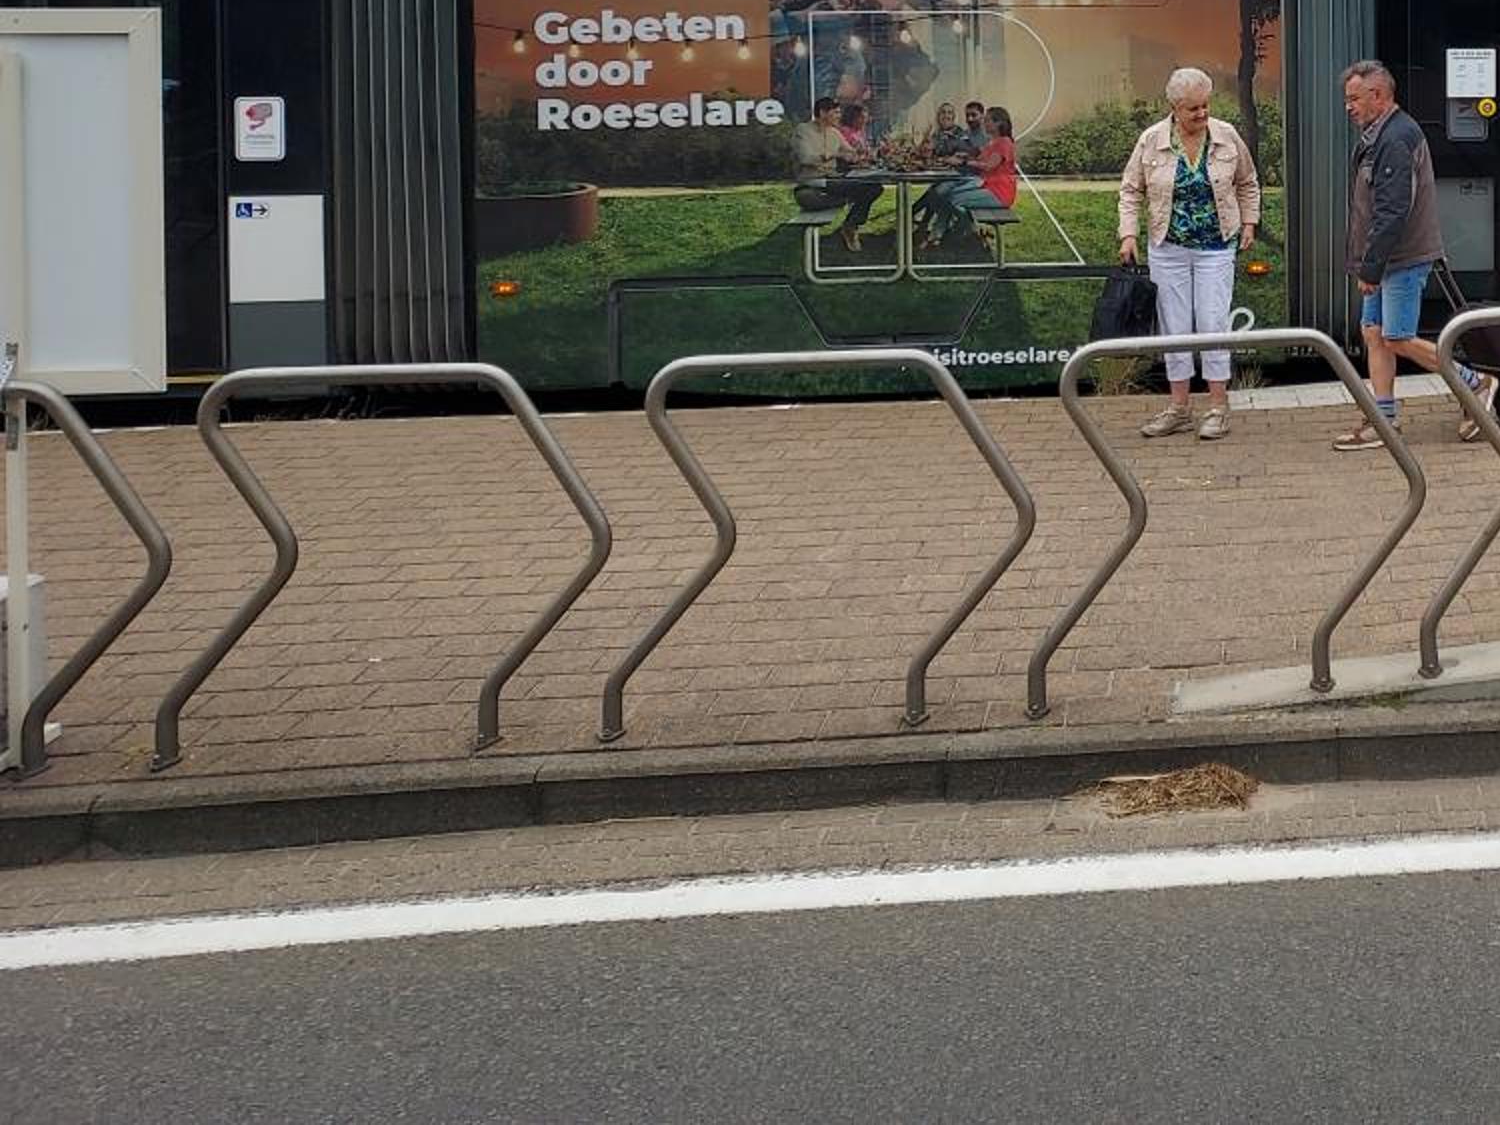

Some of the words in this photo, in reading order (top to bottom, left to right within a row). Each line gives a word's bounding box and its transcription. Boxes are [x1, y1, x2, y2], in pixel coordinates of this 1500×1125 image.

[534, 10, 746, 45] Gebeten
[535, 54, 653, 88] door
[537, 93, 786, 131] Roeselare
[931, 346, 1073, 366] isitroeselare
